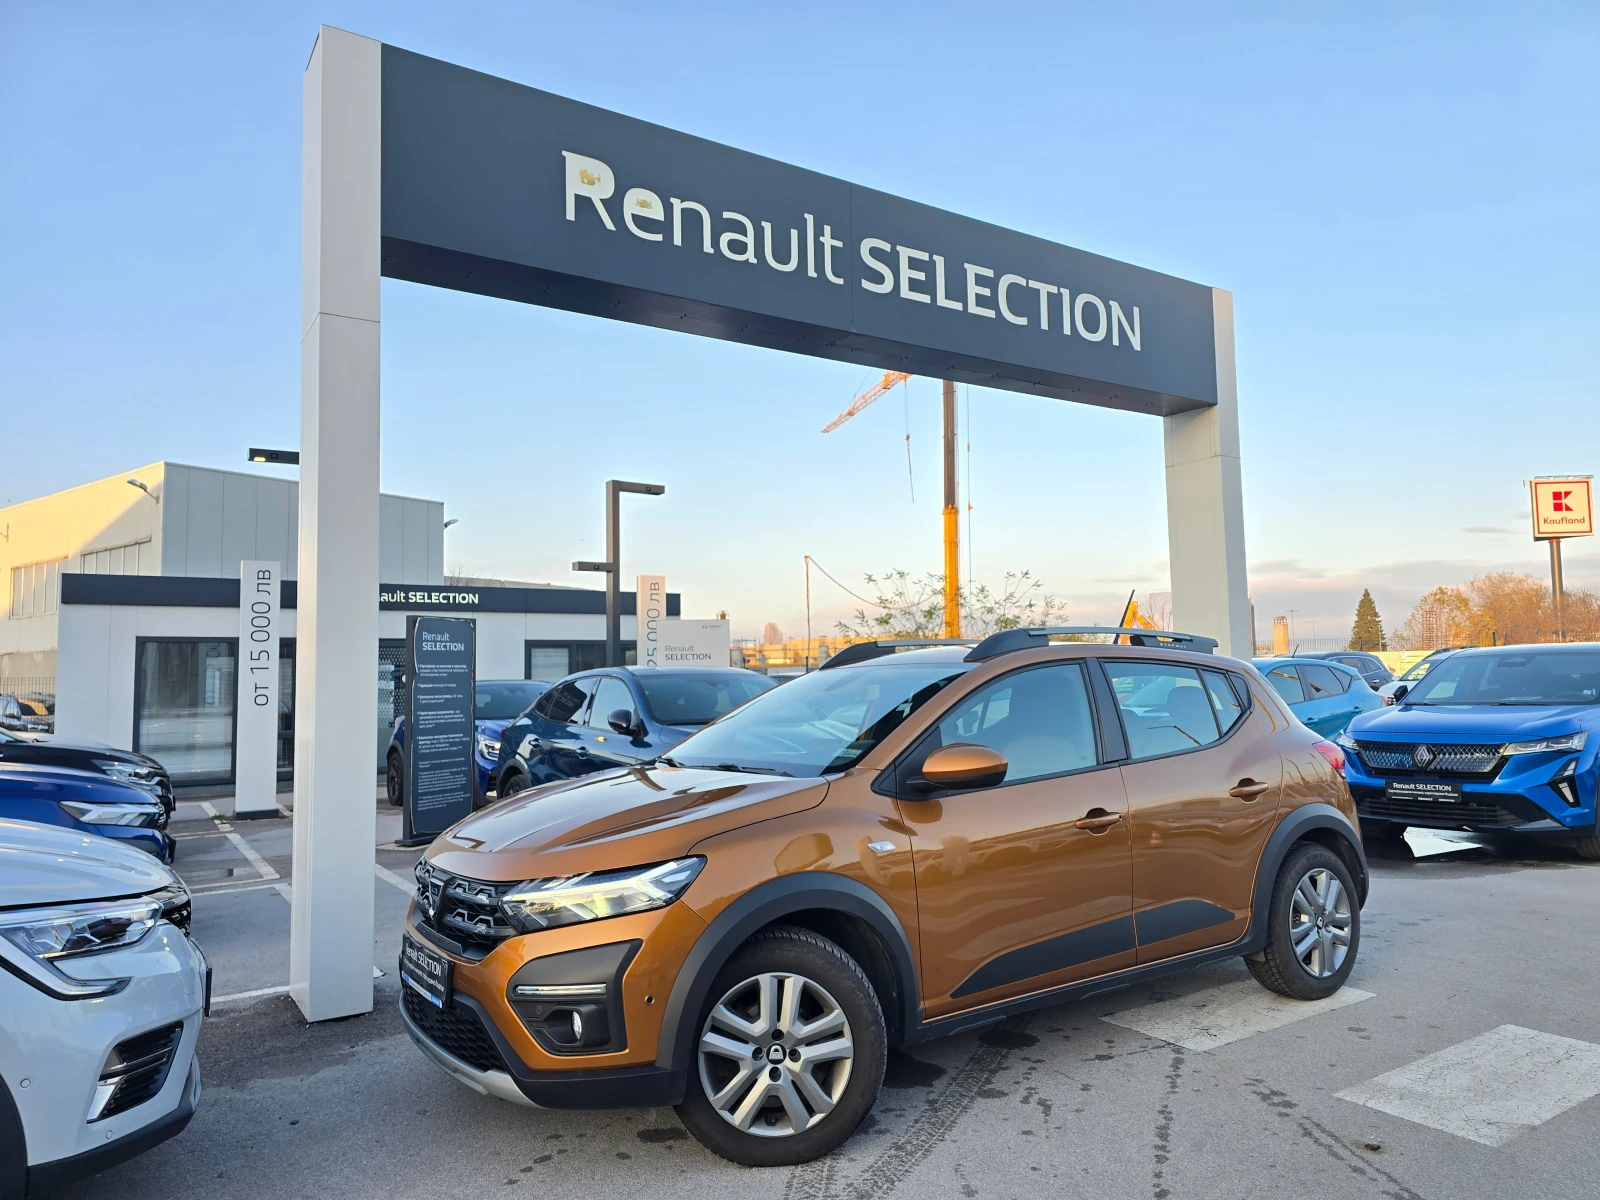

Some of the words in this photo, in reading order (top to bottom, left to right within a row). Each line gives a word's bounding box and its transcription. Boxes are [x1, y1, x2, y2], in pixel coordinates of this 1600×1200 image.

[562, 150, 844, 285] Renault
[860, 237, 1142, 351] SELECTION
[1543, 516, 1585, 525] Kaufland
[379, 590, 406, 602] ault
[408, 591, 479, 604] SELECTION
[250, 602, 271, 642] 000
[647, 608, 660, 641] 000
[422, 631, 450, 641] Renault
[422, 642, 464, 652] SELECTION
[665, 644, 695, 652] Renault
[250, 650, 270, 674] 15
[665, 653, 712, 661] SELECTION
[1392, 782, 1416, 790] Renault
[1416, 783, 1452, 792] SELECTION
